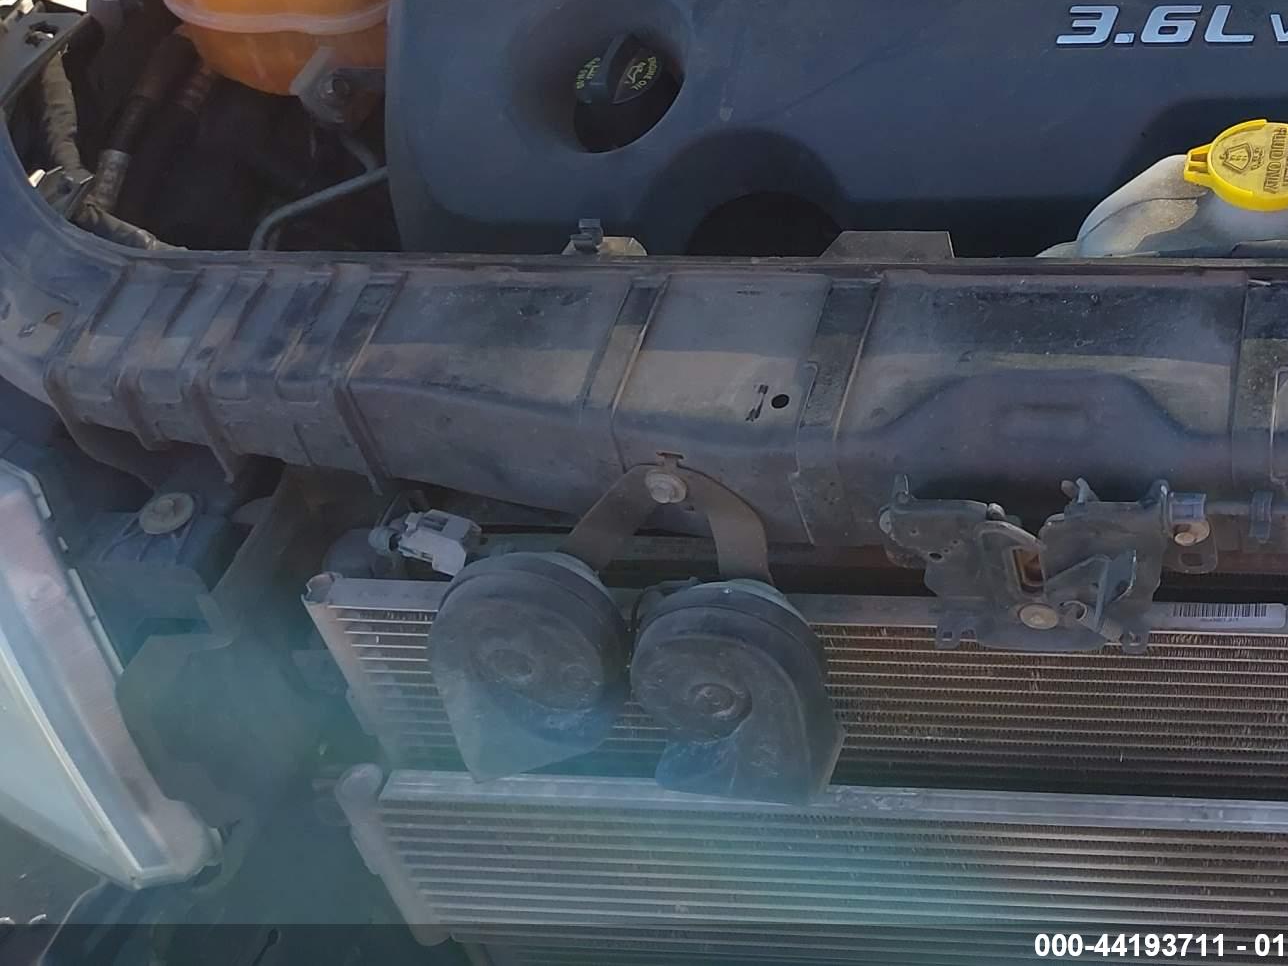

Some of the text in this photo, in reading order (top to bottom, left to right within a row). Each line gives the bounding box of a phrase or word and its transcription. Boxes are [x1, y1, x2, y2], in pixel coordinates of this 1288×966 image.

[1056, 5, 1255, 45] 3.6L
[630, 80, 647, 90] OIL
[1263, 127, 1288, 194] FLUID ONLY
